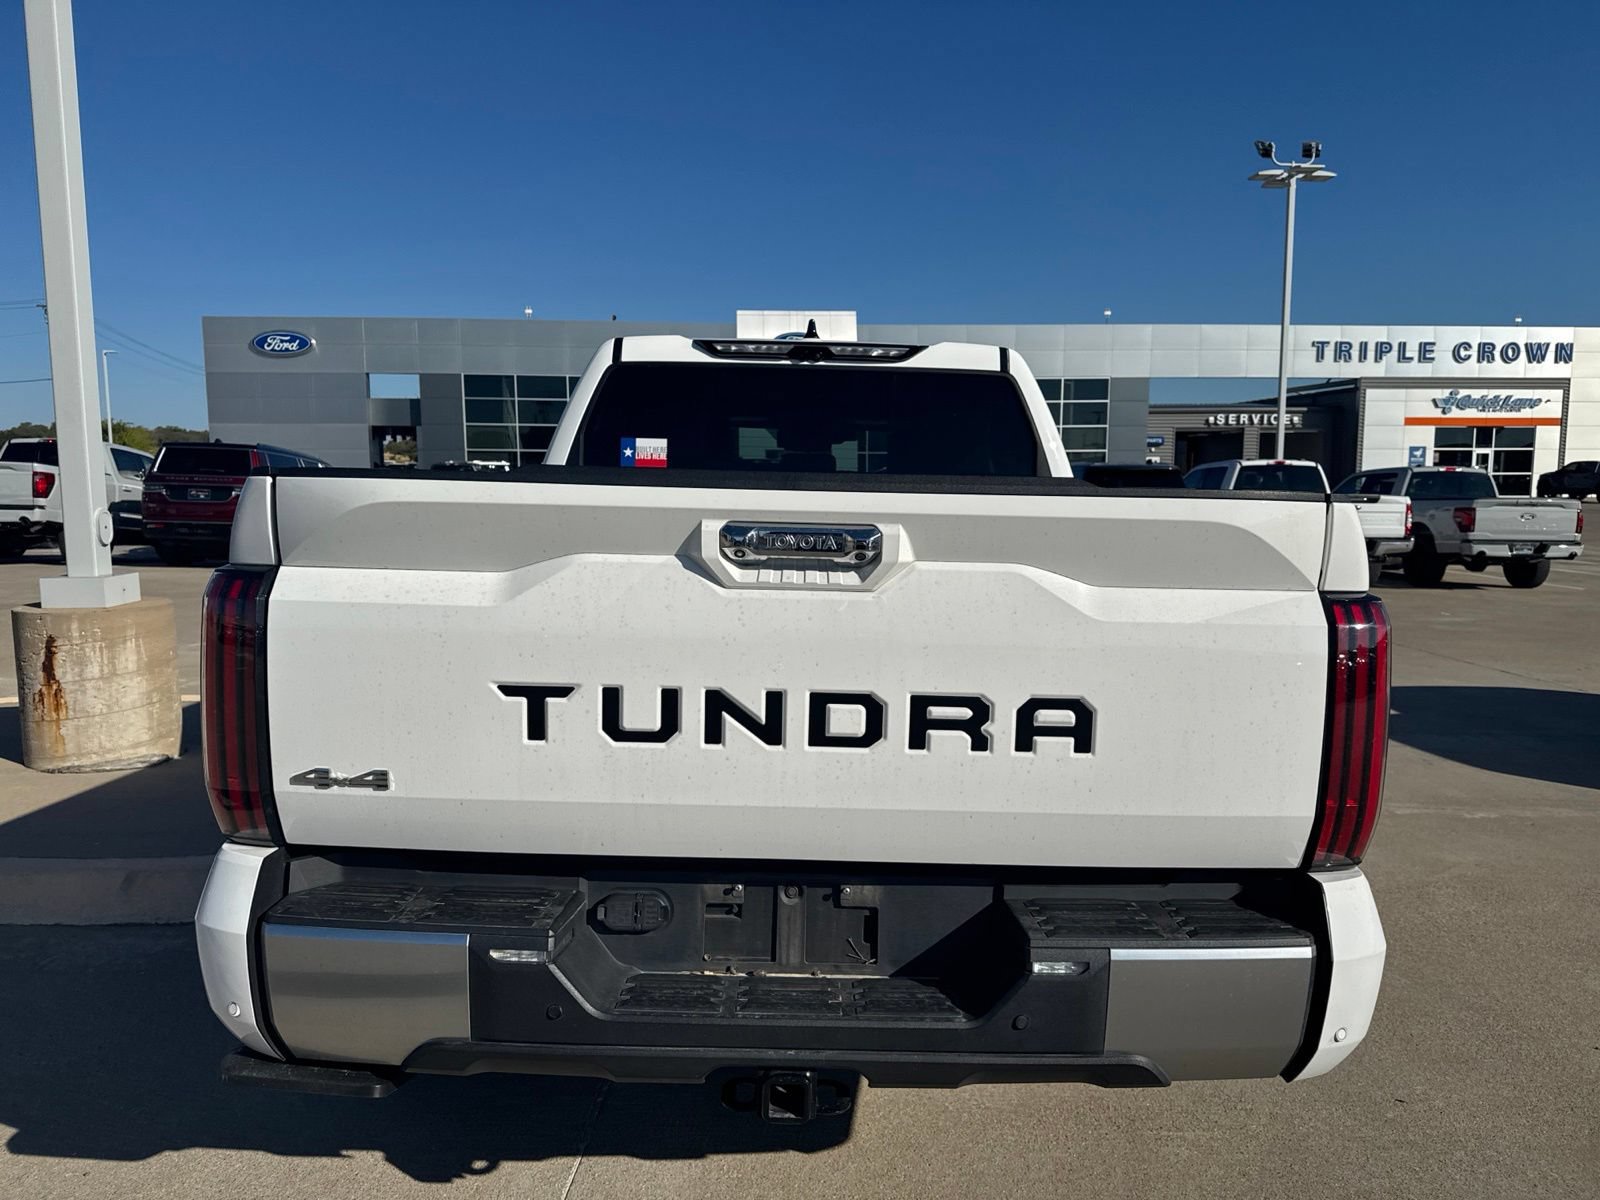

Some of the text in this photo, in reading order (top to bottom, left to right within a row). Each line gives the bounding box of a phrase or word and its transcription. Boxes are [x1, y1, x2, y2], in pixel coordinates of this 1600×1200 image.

[264, 335, 300, 351] Ford
[1311, 341, 1574, 364] TRIPLE CROWN
[1456, 394, 1542, 411] Quick Lane
[1216, 413, 1292, 426] SERVICE
[764, 534, 838, 550] TOYOTA
[490, 683, 1096, 756] TUNDRA
